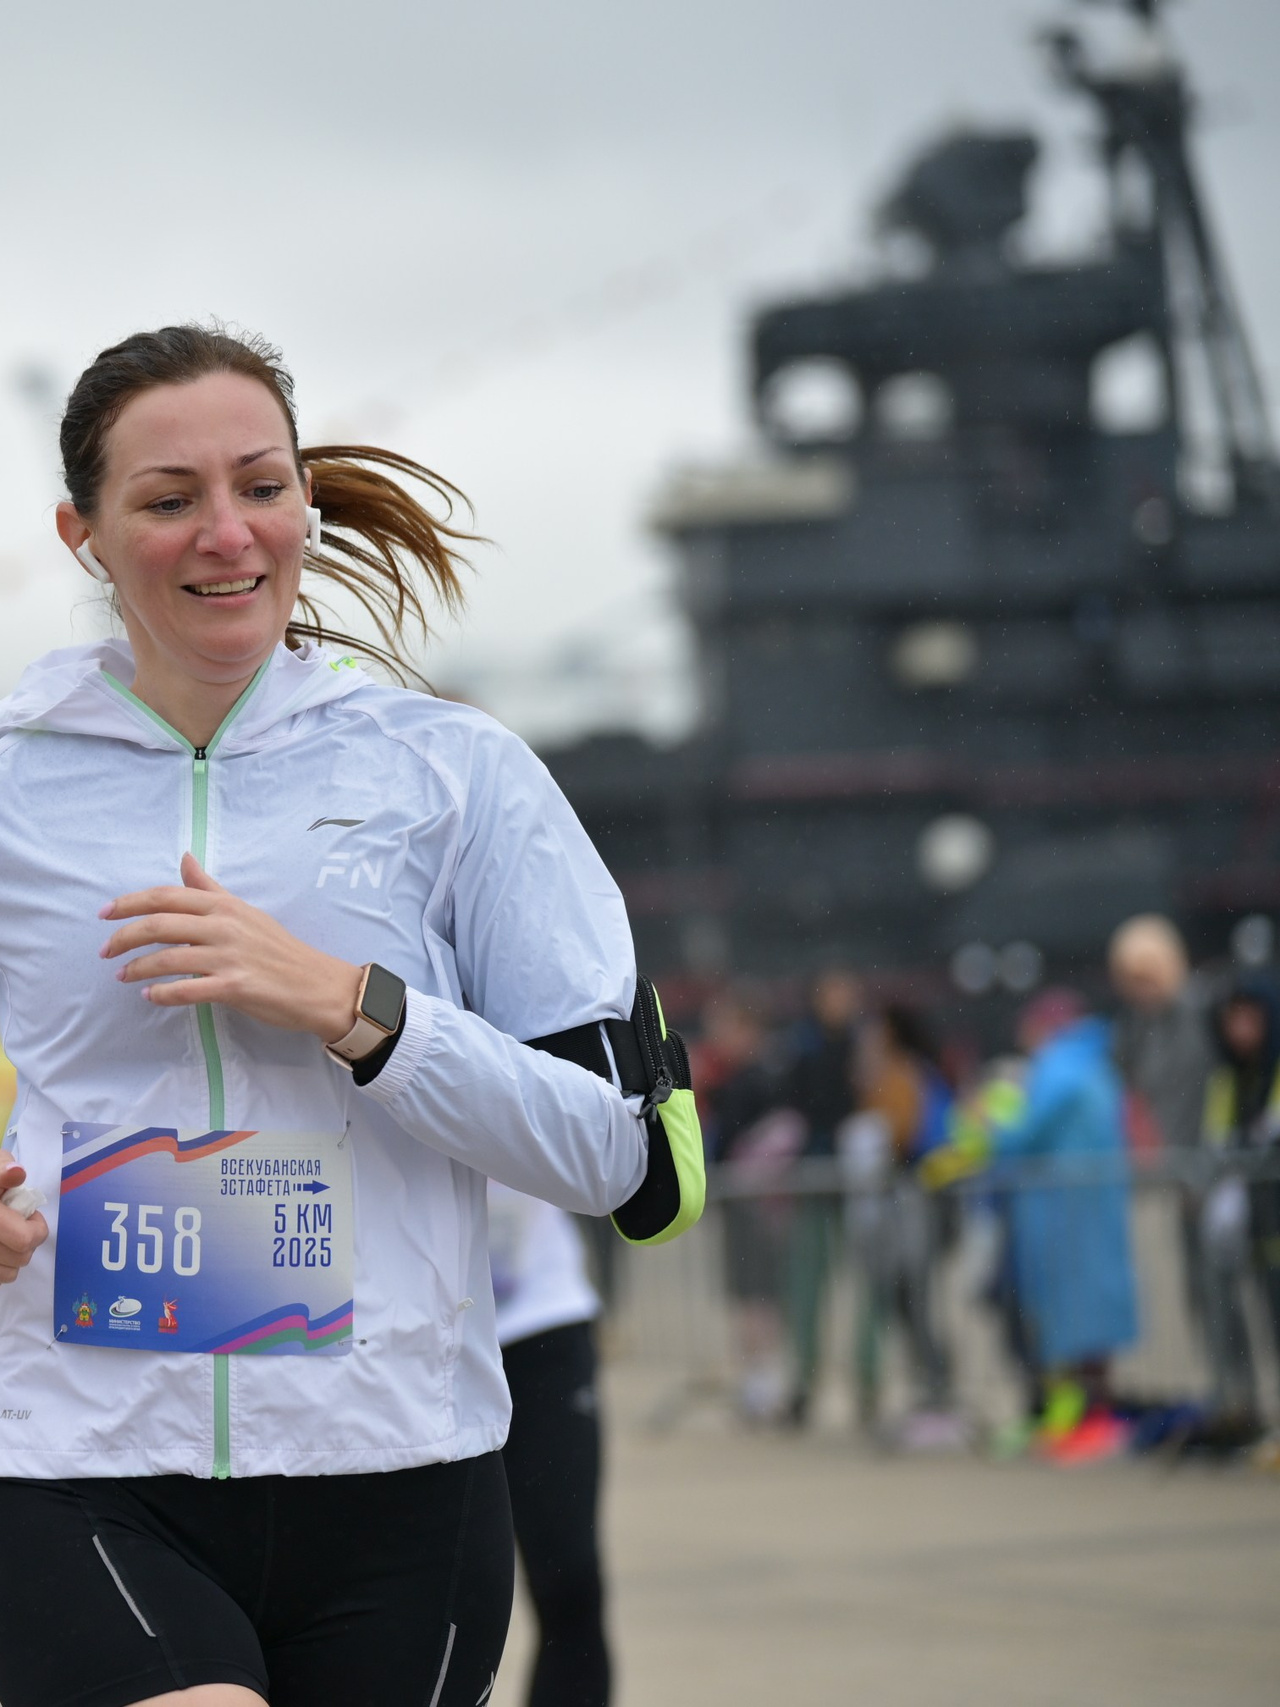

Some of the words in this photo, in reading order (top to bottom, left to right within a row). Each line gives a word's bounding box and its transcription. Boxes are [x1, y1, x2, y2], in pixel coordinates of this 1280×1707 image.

[221, 1158, 321, 1176] ВСЕКУБАНСКАЯ
[220, 1178, 290, 1196] ЭСТАФЕТА
[274, 1203, 287, 1234] 5
[101, 1202, 202, 1276] 358
[272, 1237, 332, 1267] 2025
